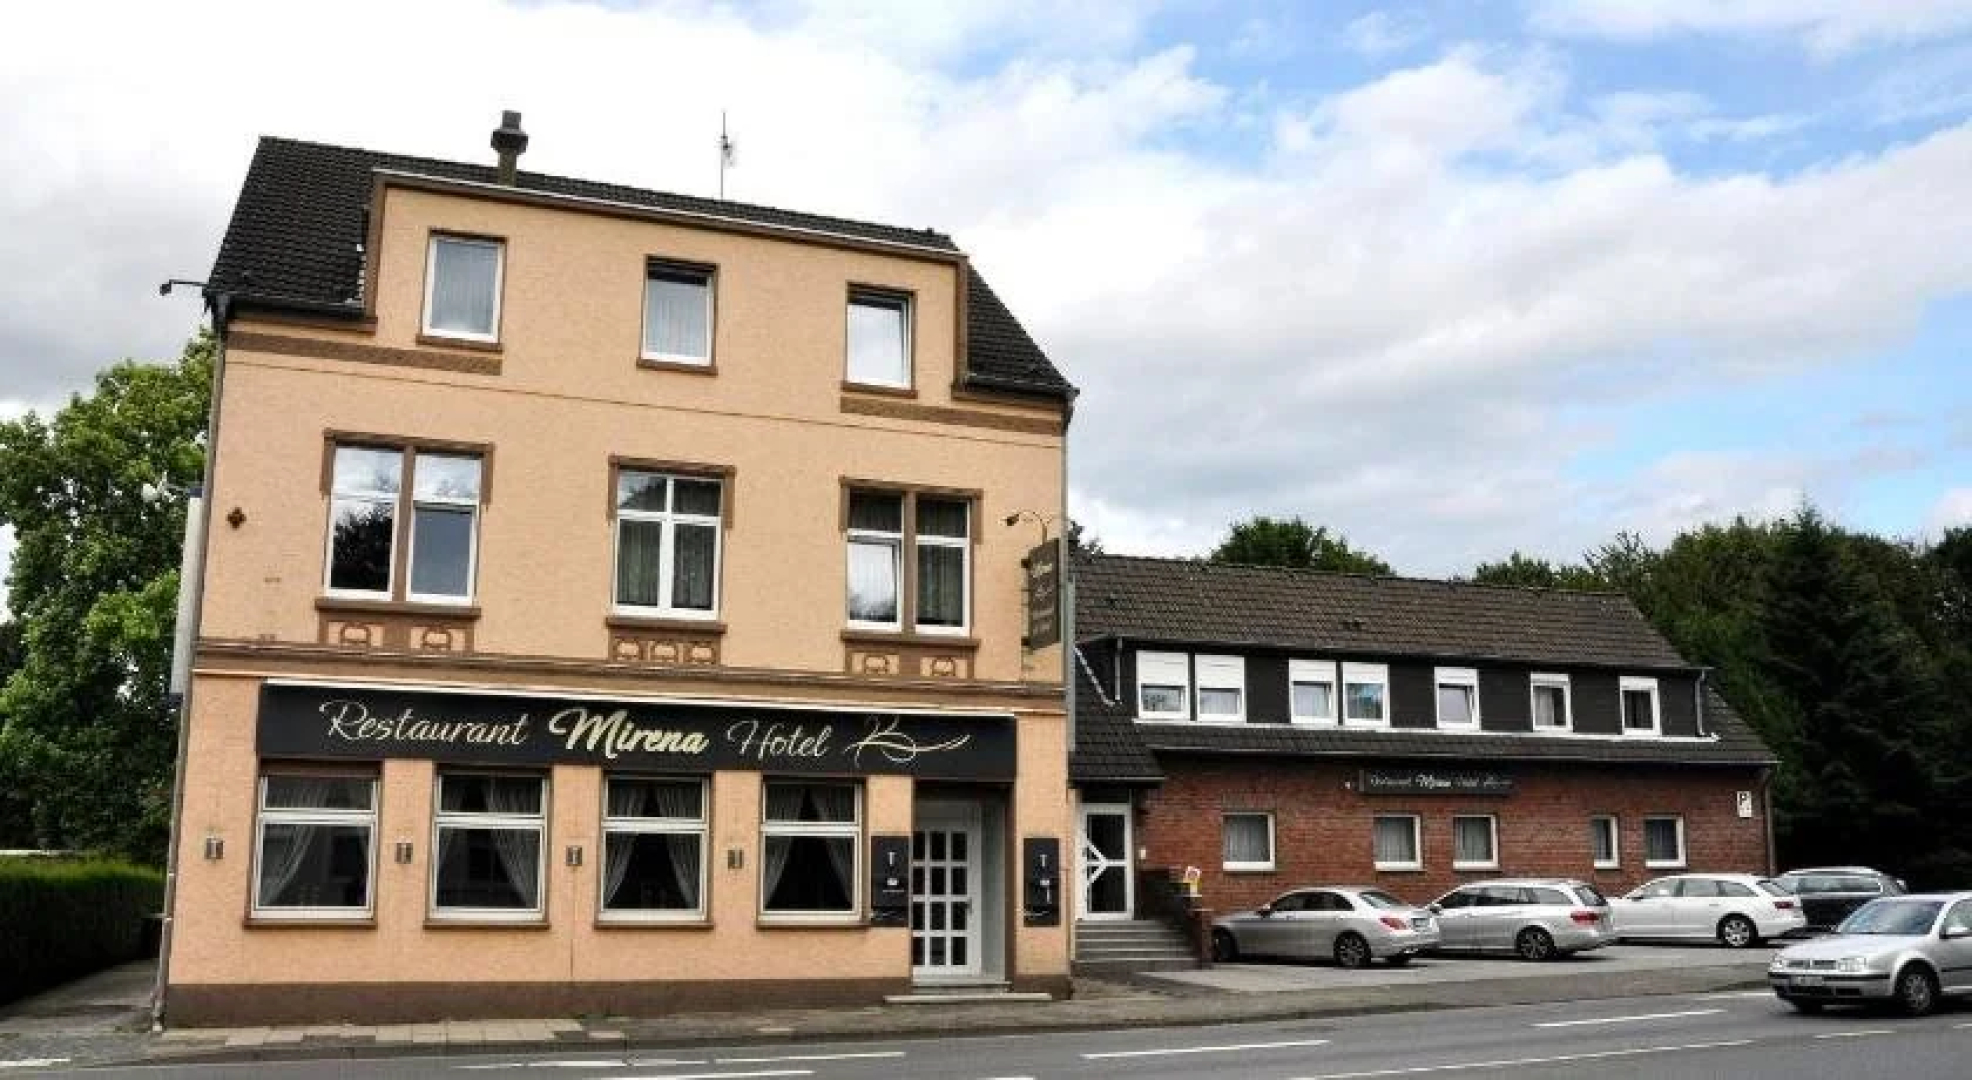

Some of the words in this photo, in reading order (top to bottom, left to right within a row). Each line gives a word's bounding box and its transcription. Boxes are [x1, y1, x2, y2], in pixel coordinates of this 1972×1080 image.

[319, 699, 529, 746] Restaurant
[548, 707, 709, 761] Mirena
[726, 718, 831, 761] Hotel
